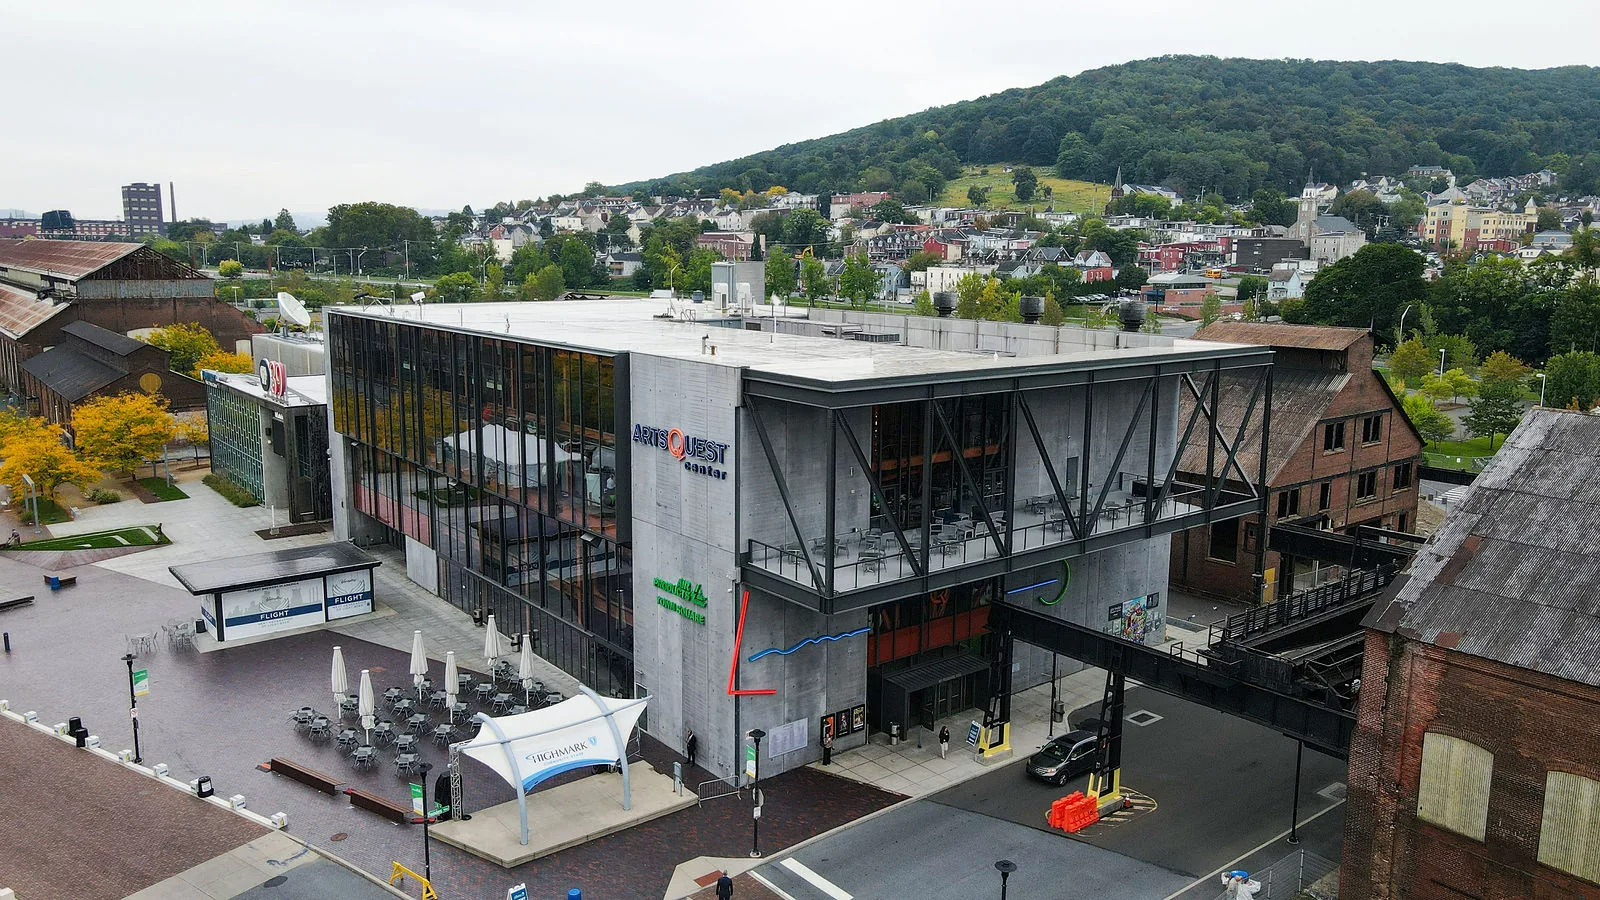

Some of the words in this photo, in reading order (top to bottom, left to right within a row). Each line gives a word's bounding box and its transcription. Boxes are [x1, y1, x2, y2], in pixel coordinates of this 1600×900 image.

[684, 462, 727, 480] center
[335, 594, 363, 604] FLIGHT
[653, 577, 692, 601] PRODUCTS
[260, 610, 290, 620] FLIGHT
[656, 596, 676, 611] TOWN
[676, 605, 705, 625] SQUARE
[532, 741, 588, 763] HIGHMARK
